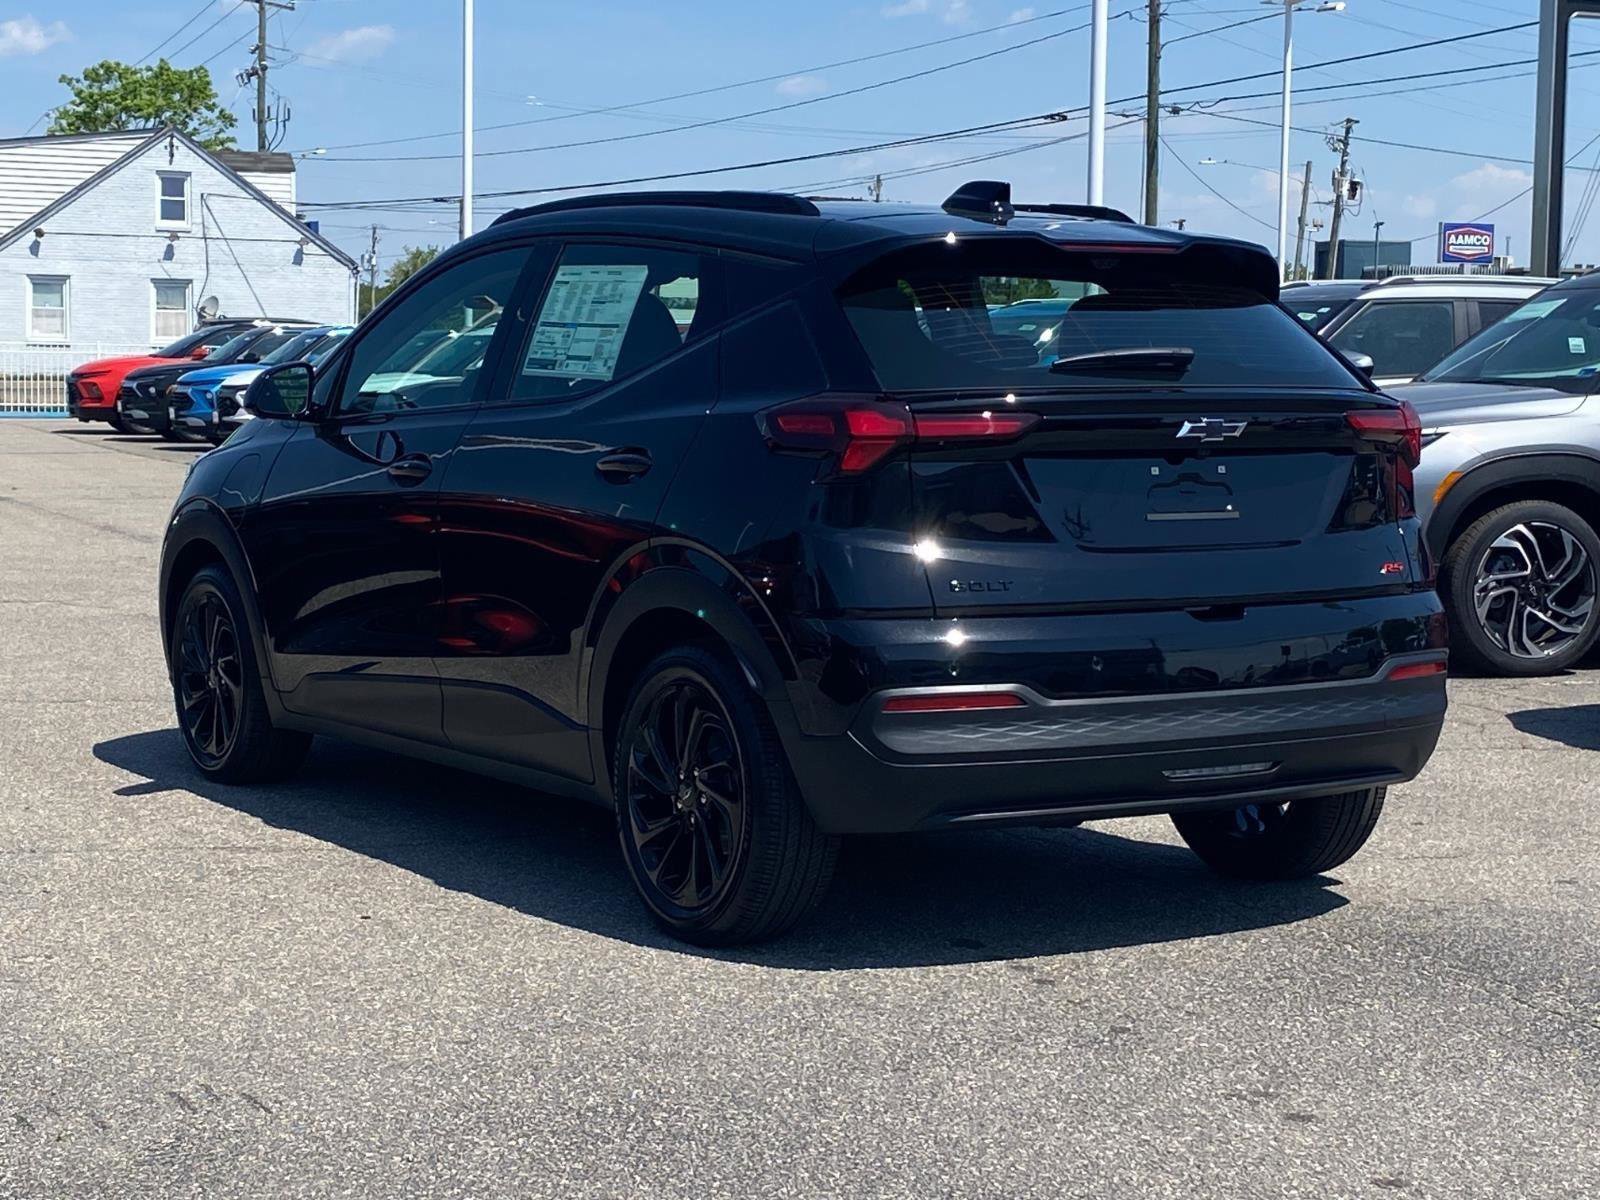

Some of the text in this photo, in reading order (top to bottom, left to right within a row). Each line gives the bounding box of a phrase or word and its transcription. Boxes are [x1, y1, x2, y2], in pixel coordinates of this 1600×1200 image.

[1448, 234, 1490, 246] AAMCO
[1380, 562, 1404, 574] RS
[949, 579, 1014, 593] BOLT
